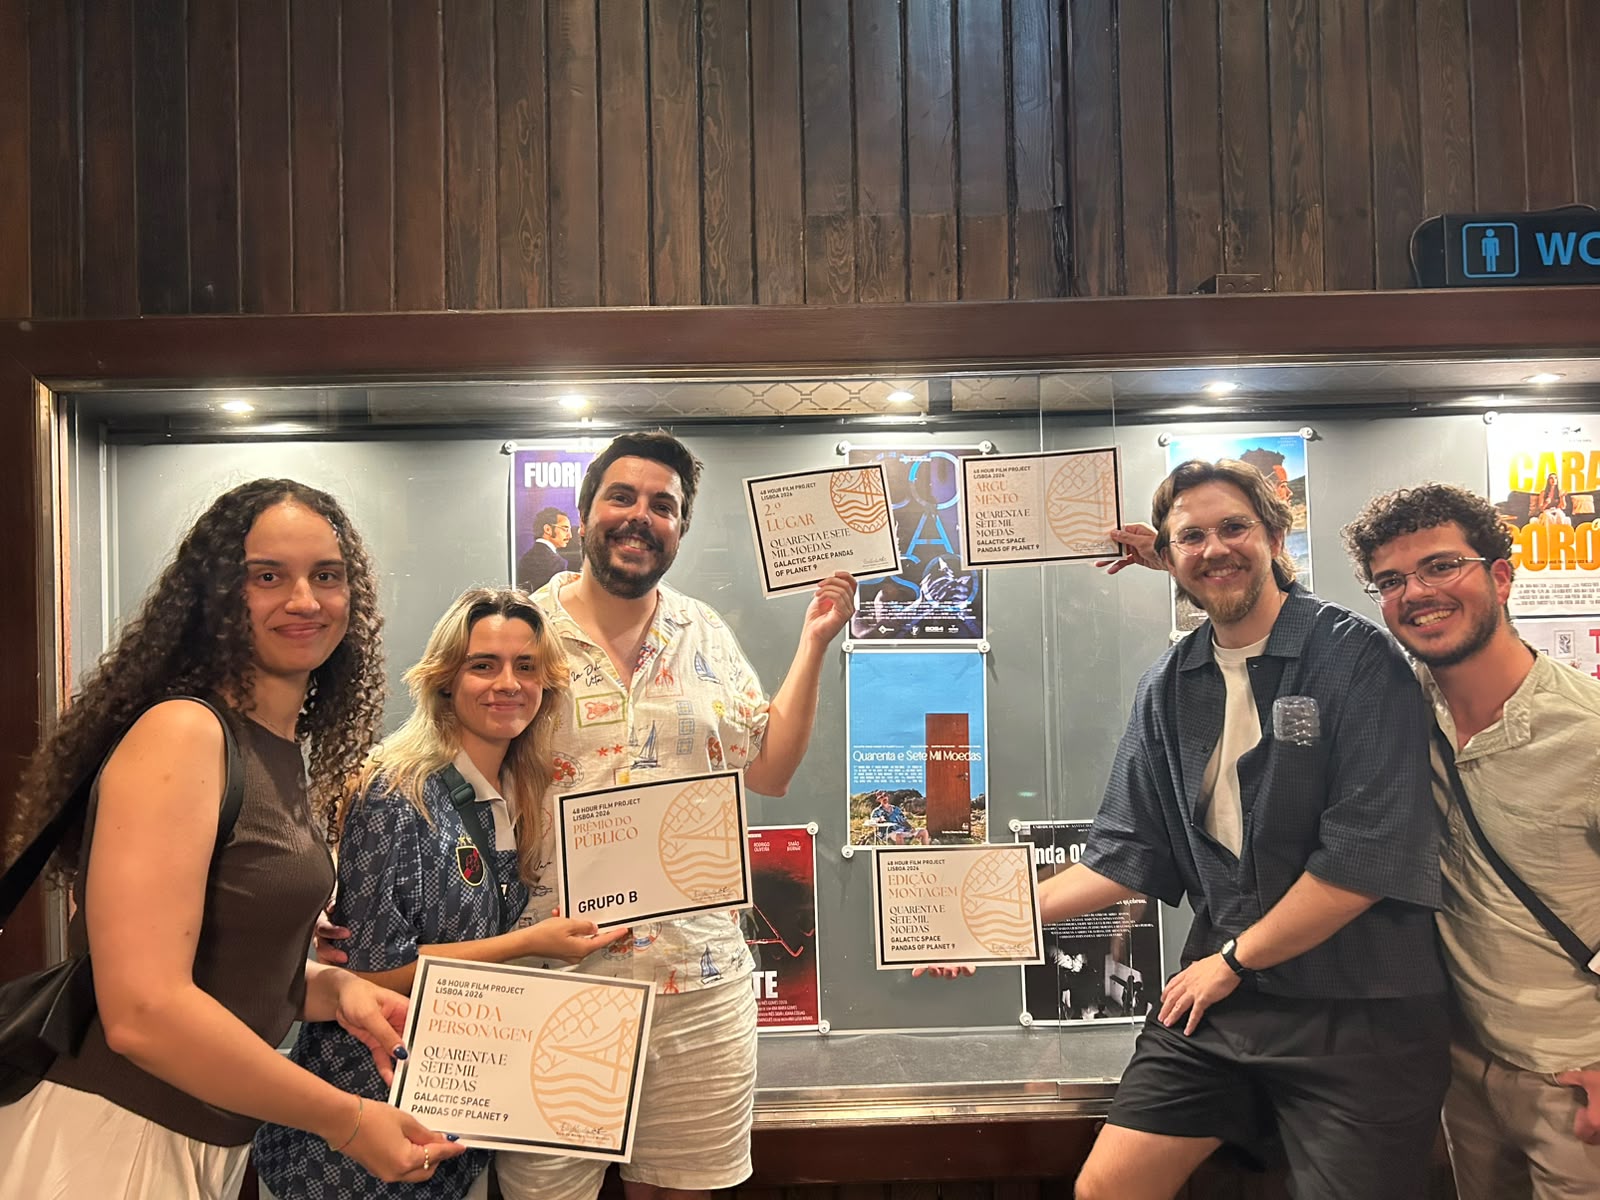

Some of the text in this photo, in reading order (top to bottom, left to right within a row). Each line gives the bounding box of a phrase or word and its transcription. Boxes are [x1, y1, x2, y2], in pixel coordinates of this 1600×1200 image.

[1536, 232, 1600, 266] WC
[524, 462, 582, 488] FUORI
[794, 482, 816, 490] PROJECT
[976, 480, 1008, 492] ARGU
[976, 493, 1018, 505] MENTO
[766, 513, 816, 532] LUGAR
[976, 510, 1024, 520] QUARENTA
[976, 518, 1014, 528] SETE MIL
[770, 528, 850, 549] QUARENTA E SETE
[976, 528, 1014, 538] MOEDAS
[772, 541, 832, 559] MIL MOEDAS
[774, 550, 854, 568] GALACTIC SPACE PANDAS
[786, 566, 812, 576] PLANET
[853, 750, 896, 762] Quarenta
[906, 751, 927, 761] Sete
[930, 750, 941, 761] Mil
[943, 751, 981, 761] Moedas
[581, 805, 598, 813] HOUR
[599, 802, 613, 811] FILM
[614, 798, 640, 808] PROJECT
[573, 810, 610, 821] LISBOA 2026
[615, 815, 632, 829] DO
[574, 826, 638, 849] PÚBLICO
[888, 873, 937, 887] EDIÇÃO
[888, 886, 958, 899] MONTAGEM
[578, 891, 638, 913] GRUPO B
[890, 905, 938, 915] QUARENTA
[890, 915, 929, 925] SETE MIL
[890, 925, 929, 934] MOEDAS
[435, 987, 483, 999] LISBOA 2026
[448, 980, 470, 989] HOUR
[471, 982, 489, 991] FILM
[490, 984, 524, 995] PROJECT
[432, 999, 502, 1022] USO DA
[428, 1018, 533, 1043] PERSONAGEM
[424, 1046, 508, 1066] QUARENTA E
[419, 1060, 479, 1078] SETE MIL
[416, 1075, 477, 1092] MOEDAS
[414, 1092, 490, 1107] GALACTIC SPACE
[411, 1104, 509, 1122] PANDAS OF PLANET 9
